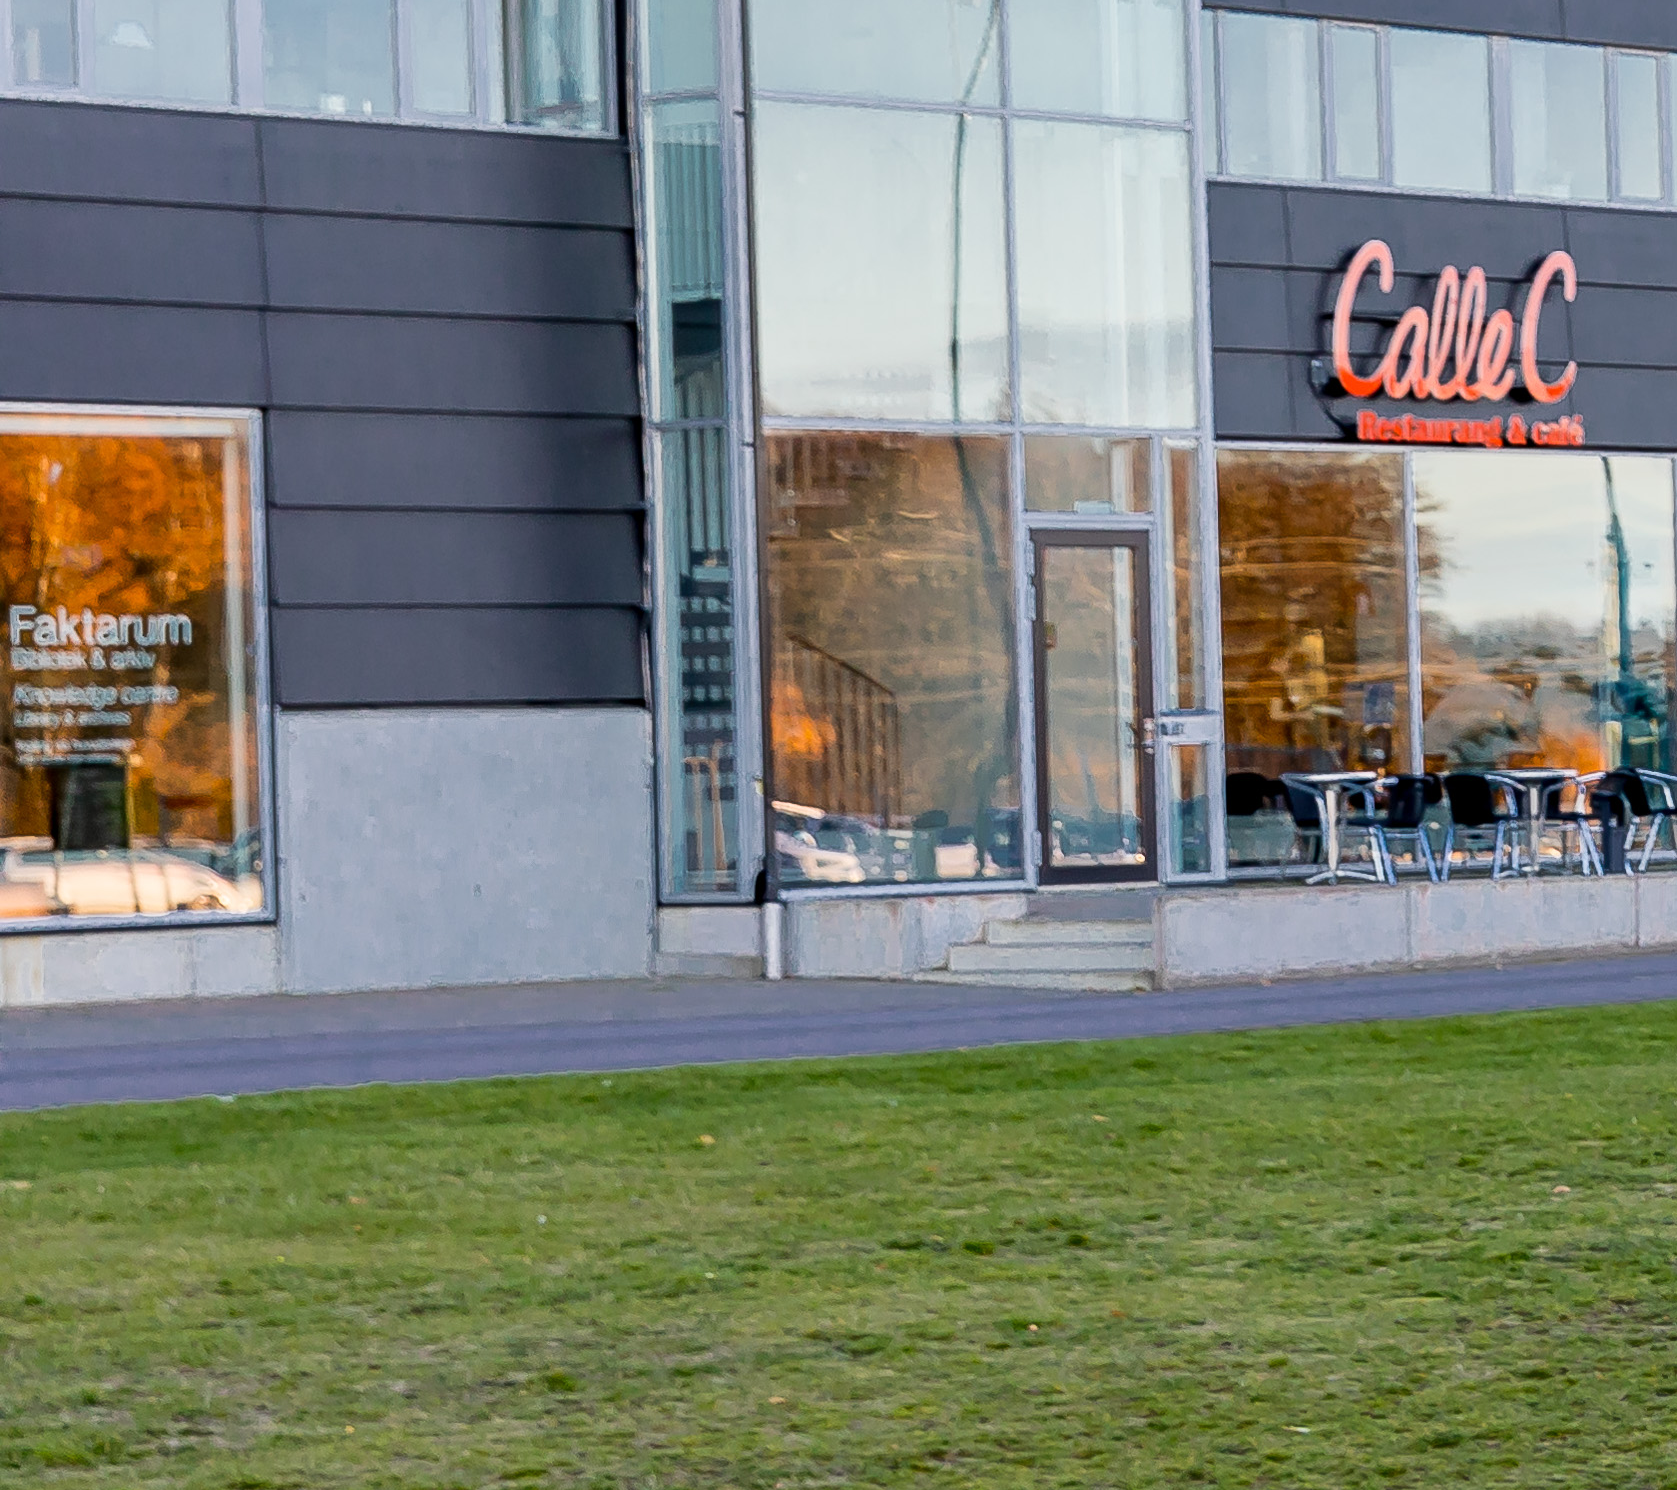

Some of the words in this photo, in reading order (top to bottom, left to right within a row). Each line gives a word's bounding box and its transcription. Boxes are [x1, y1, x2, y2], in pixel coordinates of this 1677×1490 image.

[1333, 240, 1516, 401] Calle
[1520, 250, 1578, 403] C
[1357, 410, 1503, 448] Restaurang
[1506, 414, 1528, 445] &
[1532, 413, 1585, 446] café
[10, 604, 192, 646] Faktarum
